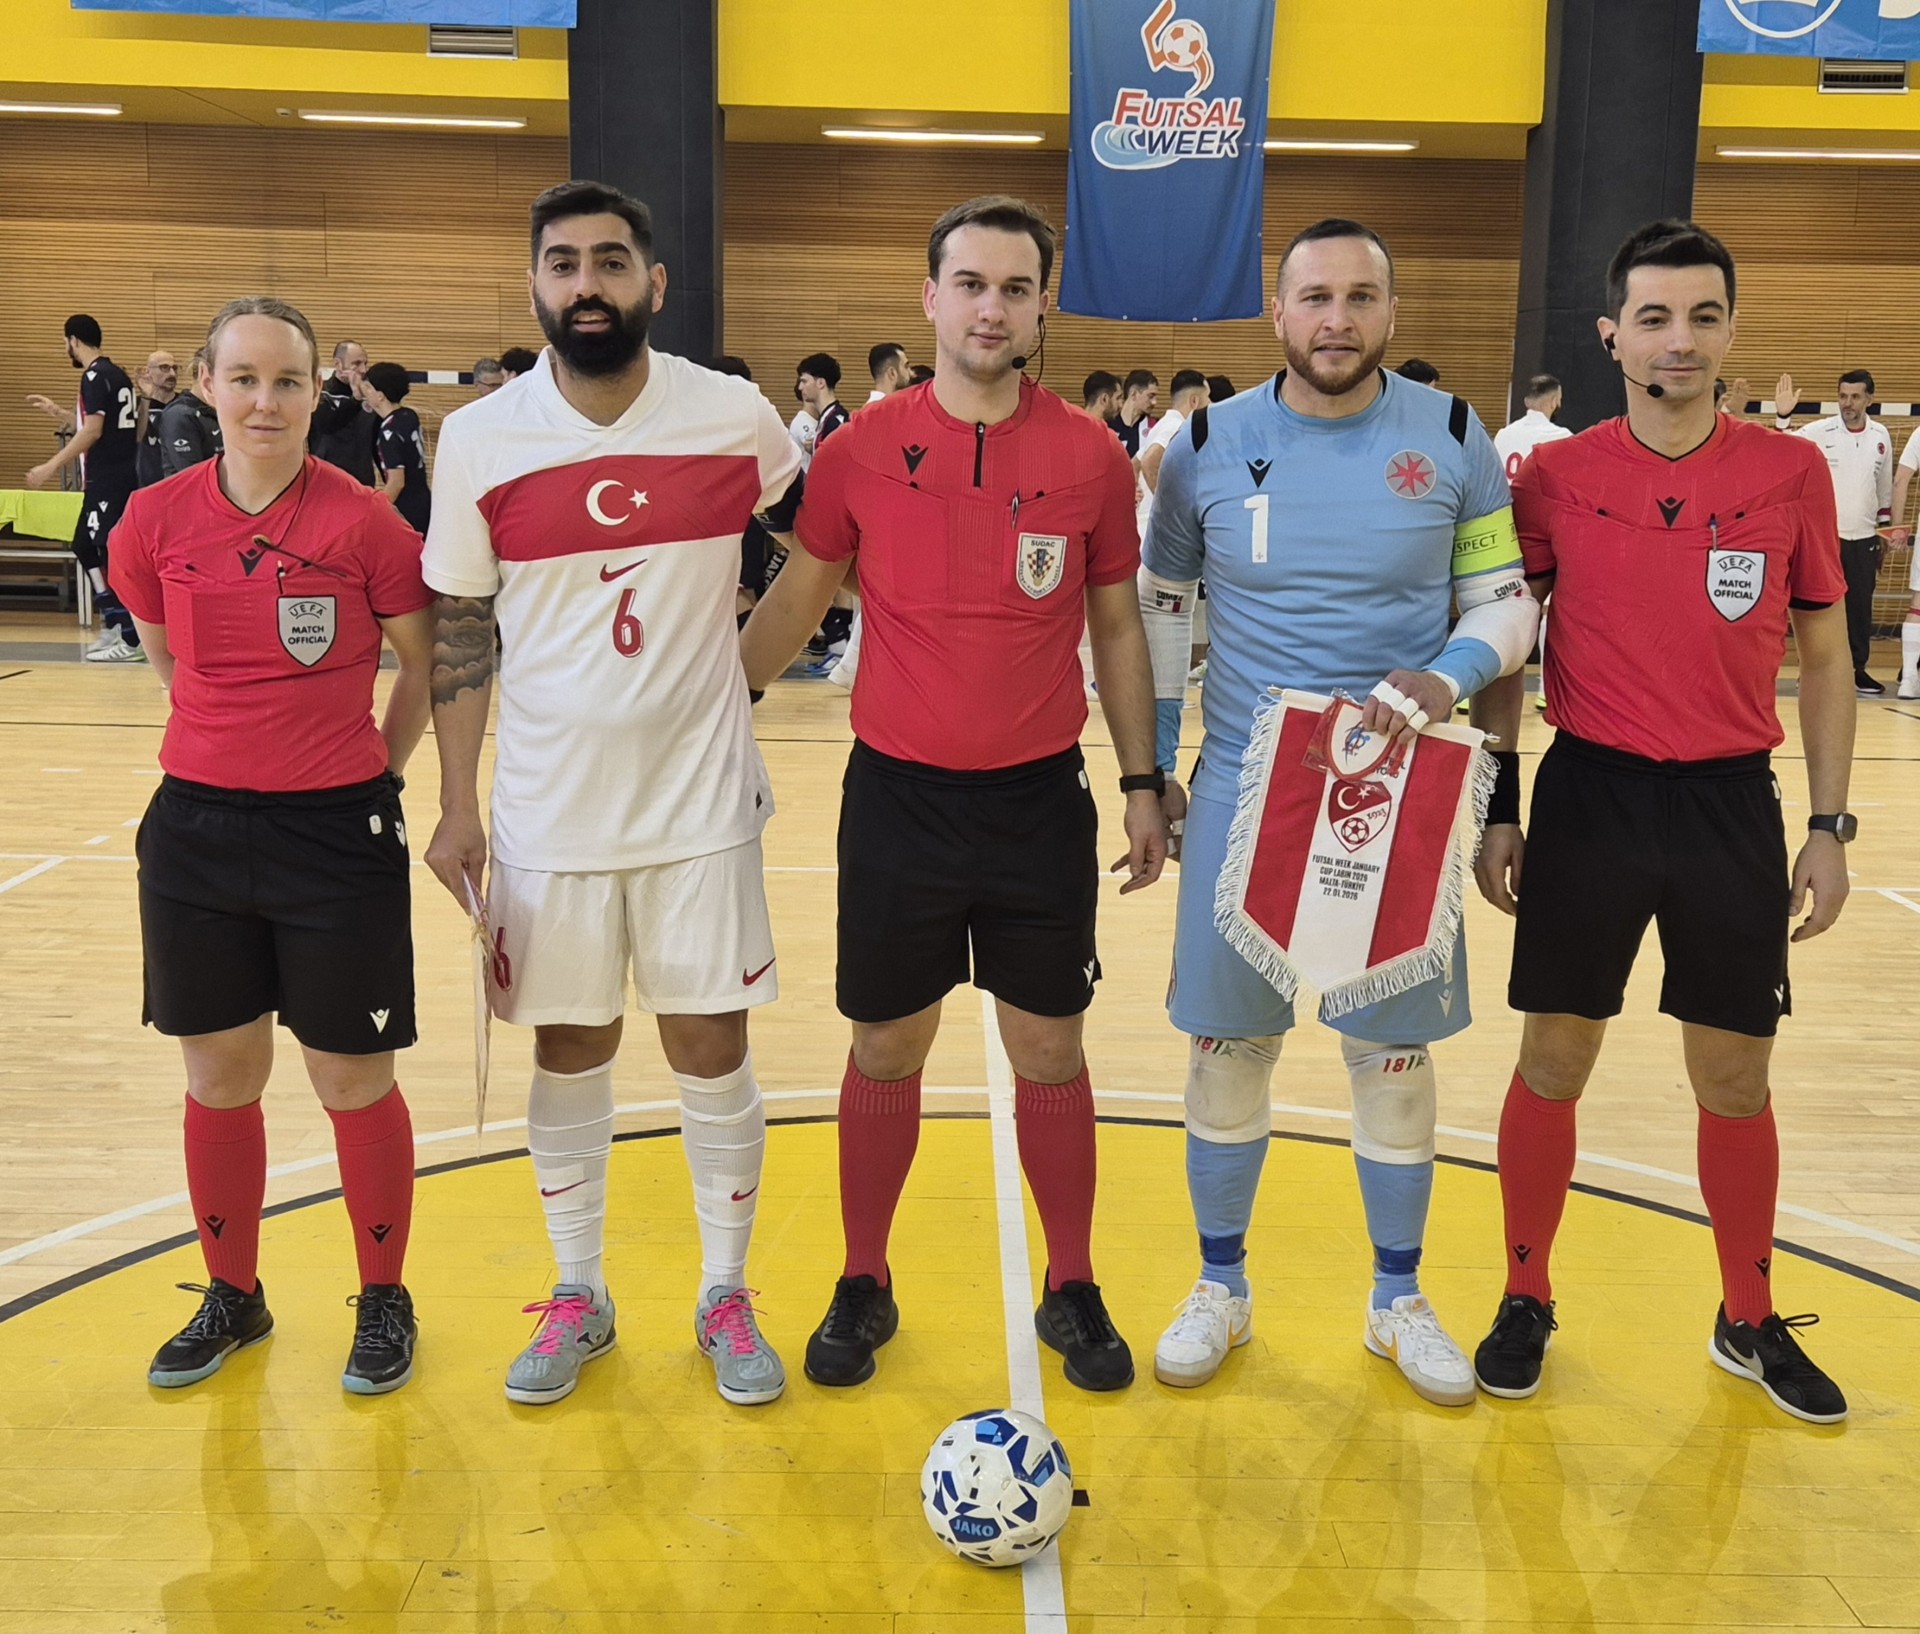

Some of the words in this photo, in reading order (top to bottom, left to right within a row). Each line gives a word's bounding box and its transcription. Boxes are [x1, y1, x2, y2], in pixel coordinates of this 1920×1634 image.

[1114, 91, 1245, 127] FUTSAL
[1147, 129, 1239, 155] WEEK
[1244, 494, 1269, 563] 1
[1453, 533, 1498, 553] SPECT
[1718, 557, 1753, 571] UEFA
[1718, 579, 1752, 589] MATCH
[1713, 589, 1754, 600] OFFICIAL
[289, 604, 324, 617] UEFA
[291, 625, 324, 634] MATCH
[612, 588, 645, 658] 6
[287, 635, 328, 645] OFFICIAL
[1312, 854, 1334, 866] FUTSAL
[1335, 858, 1352, 869] WEEK
[1352, 861, 1380, 874] JANUARY
[1320, 866, 1333, 875] CUP
[494, 926, 512, 991] 6
[953, 1519, 994, 1537] JAKO
